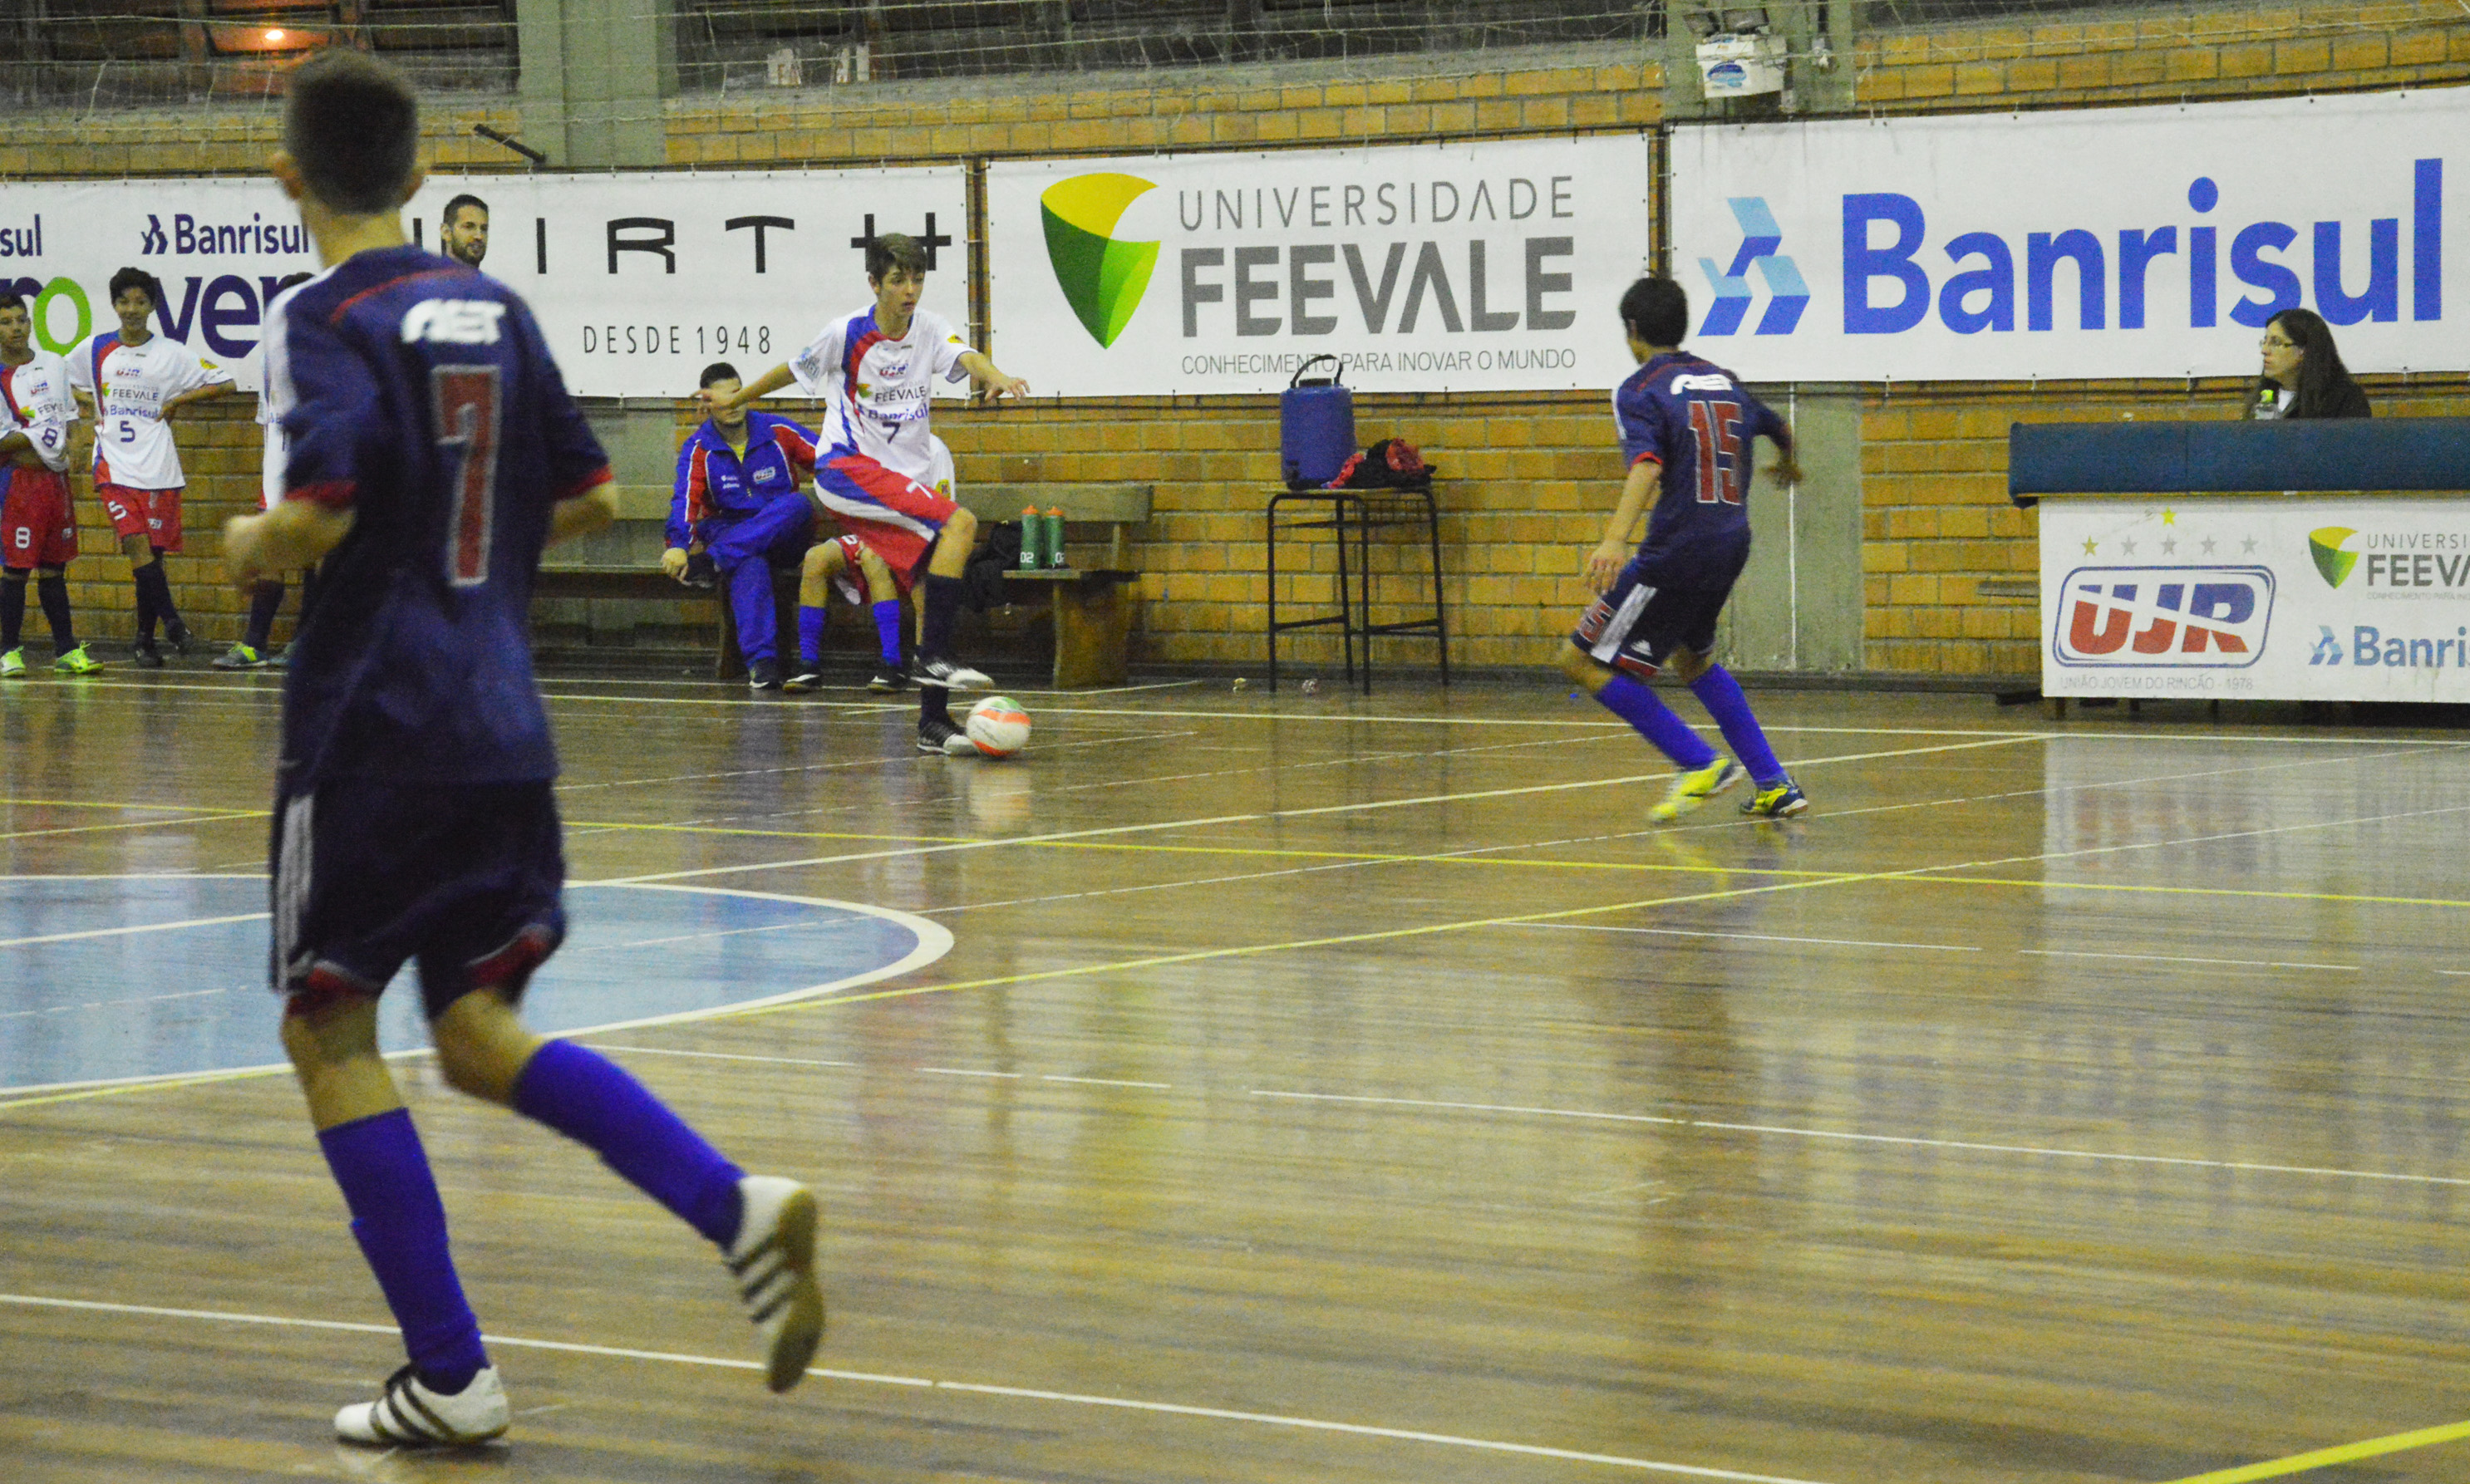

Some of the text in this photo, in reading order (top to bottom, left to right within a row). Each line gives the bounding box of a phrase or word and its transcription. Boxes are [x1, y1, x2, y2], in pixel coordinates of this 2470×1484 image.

[1179, 175, 1574, 232] UNIVERSIDADE
[175, 212, 309, 254] Banrisul
[1843, 158, 2443, 335] Banrisul
[1181, 236, 1577, 337] FEEVALE
[584, 325, 770, 355] DESDE 1948
[1183, 348, 1577, 375] CONHECIMENTO PARA INOVAR O MUNDO
[113, 388, 159, 401] FEEVALE
[875, 386, 926, 402] FEEVALE
[42, 427, 58, 448] 8
[120, 420, 135, 442] 5
[882, 421, 900, 444] 7
[1688, 400, 1744, 505] 15
[431, 364, 501, 587] 7
[108, 500, 127, 521] 5
[15, 526, 31, 549] 8
[2368, 533, 2467, 550] UNIVERSI
[1020, 551, 1035, 563] 02
[2069, 583, 2256, 655] UJR
[2100, 676, 2143, 690] JOVEM
[2145, 676, 2164, 690] DO
[2226, 677, 2254, 691] 1978
